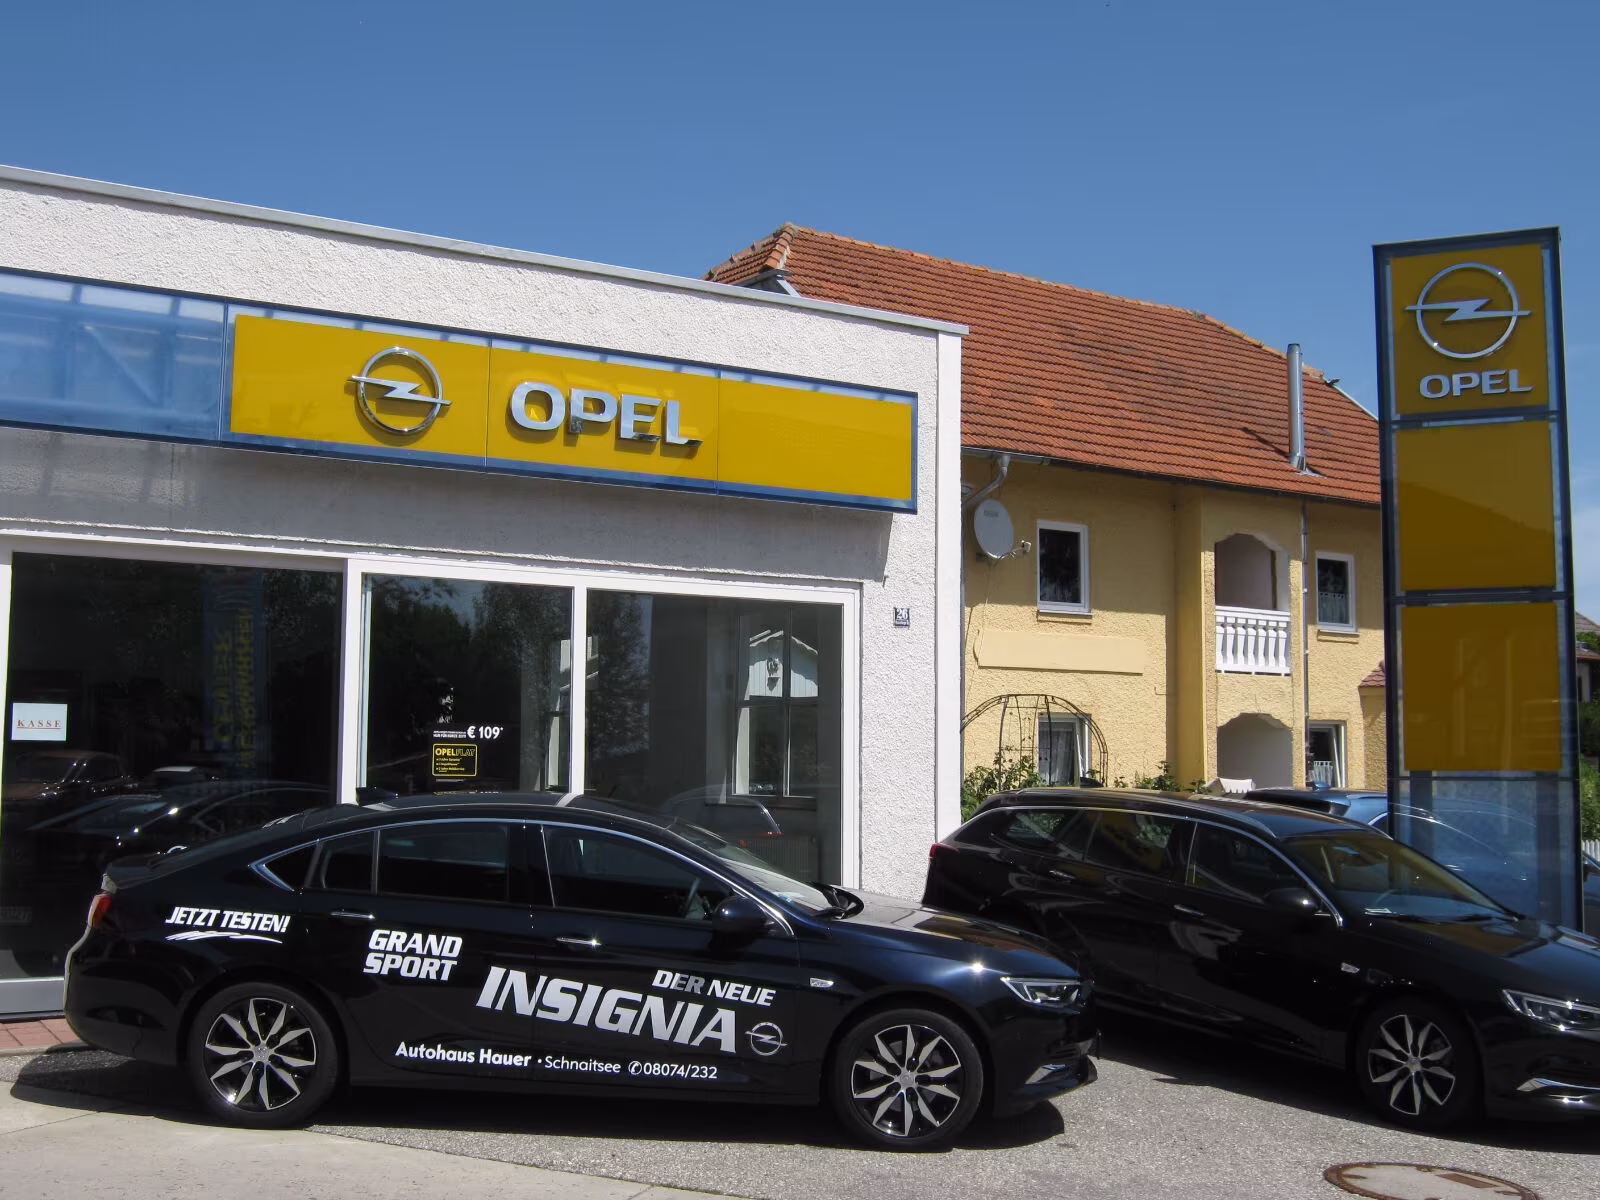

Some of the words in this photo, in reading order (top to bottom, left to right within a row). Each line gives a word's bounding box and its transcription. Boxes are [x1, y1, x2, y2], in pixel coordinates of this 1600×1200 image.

[1419, 369, 1533, 399] OPEL
[511, 381, 704, 446] OPEL
[17, 719, 61, 728] KASSE
[466, 726, 476, 739] €
[165, 906, 220, 927] JETZT
[220, 910, 291, 933] TESTEN!
[368, 929, 463, 958] GRAND
[363, 952, 458, 981] SPORT
[651, 969, 705, 994] DER
[707, 979, 776, 1007] NEUE
[475, 965, 737, 1053] INSIGNIA
[395, 1041, 475, 1063] Autohaus
[479, 1048, 532, 1067] Hauer
[544, 1055, 622, 1074] Schnaitsee
[643, 1062, 718, 1079] 08074/232
